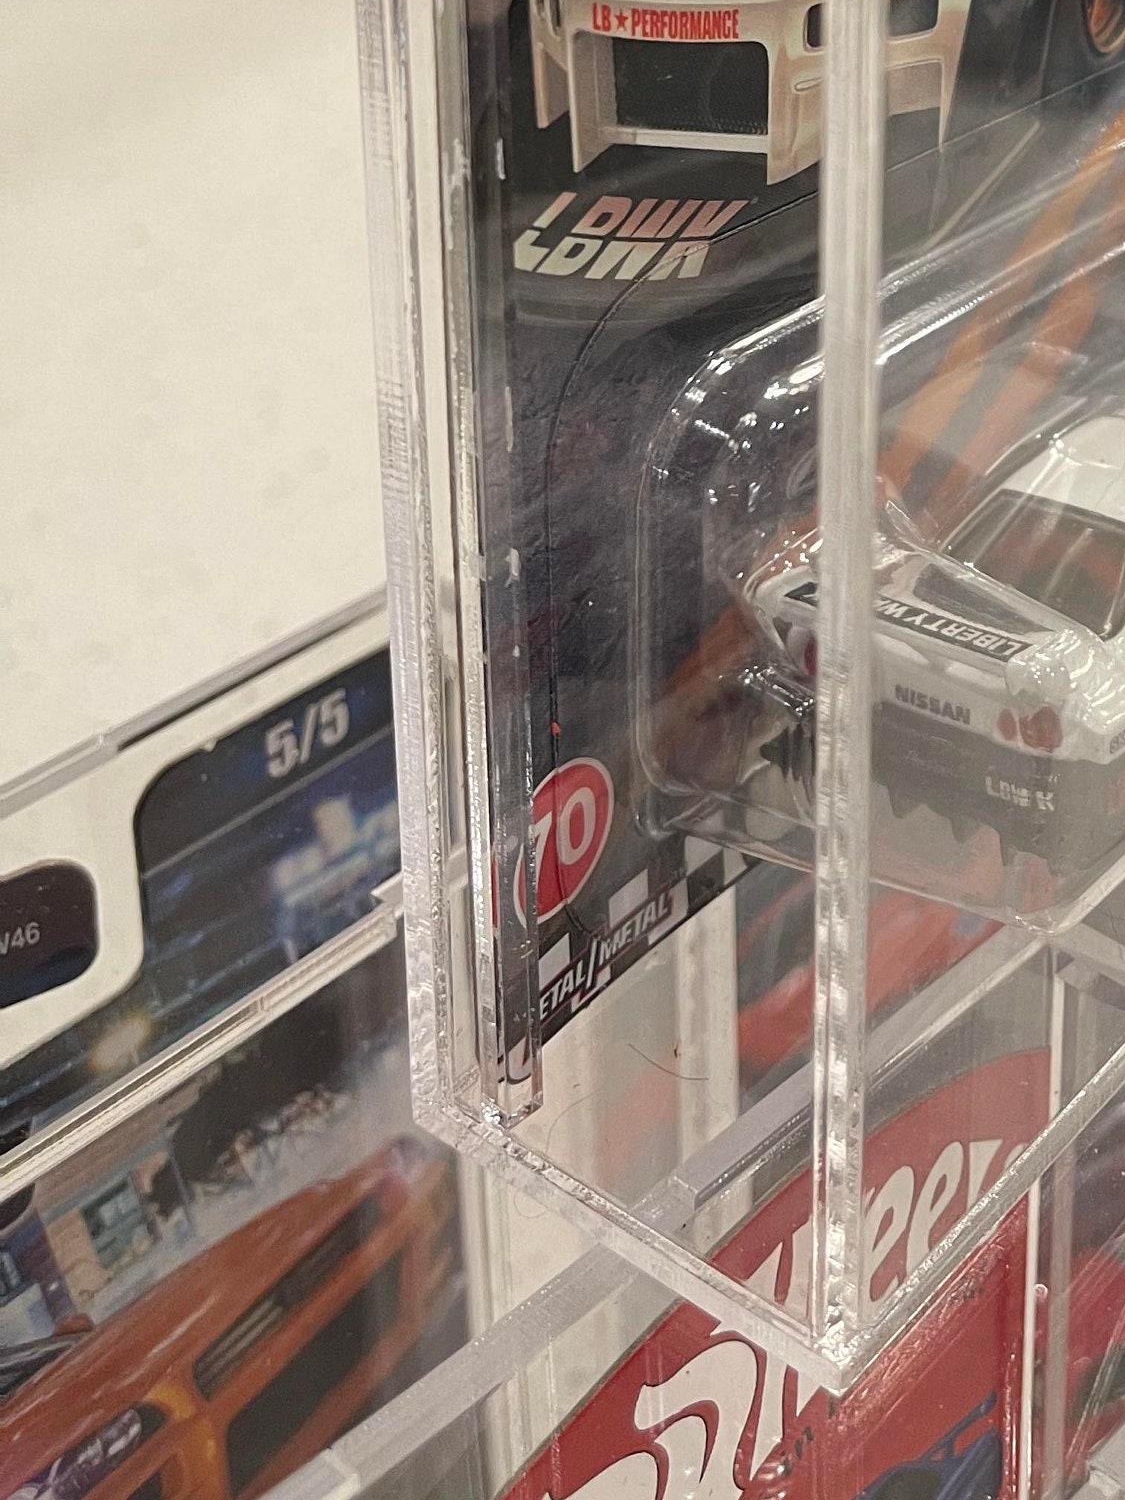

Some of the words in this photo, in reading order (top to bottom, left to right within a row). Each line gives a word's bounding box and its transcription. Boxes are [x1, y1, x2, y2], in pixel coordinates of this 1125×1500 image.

[592, 2, 612, 32] LB
[630, 8, 740, 40] PERFORMANCE
[266, 687, 350, 778] 5/5
[894, 684, 971, 725] NISSAN
[539, 890, 670, 1021] ETAL/METAL
